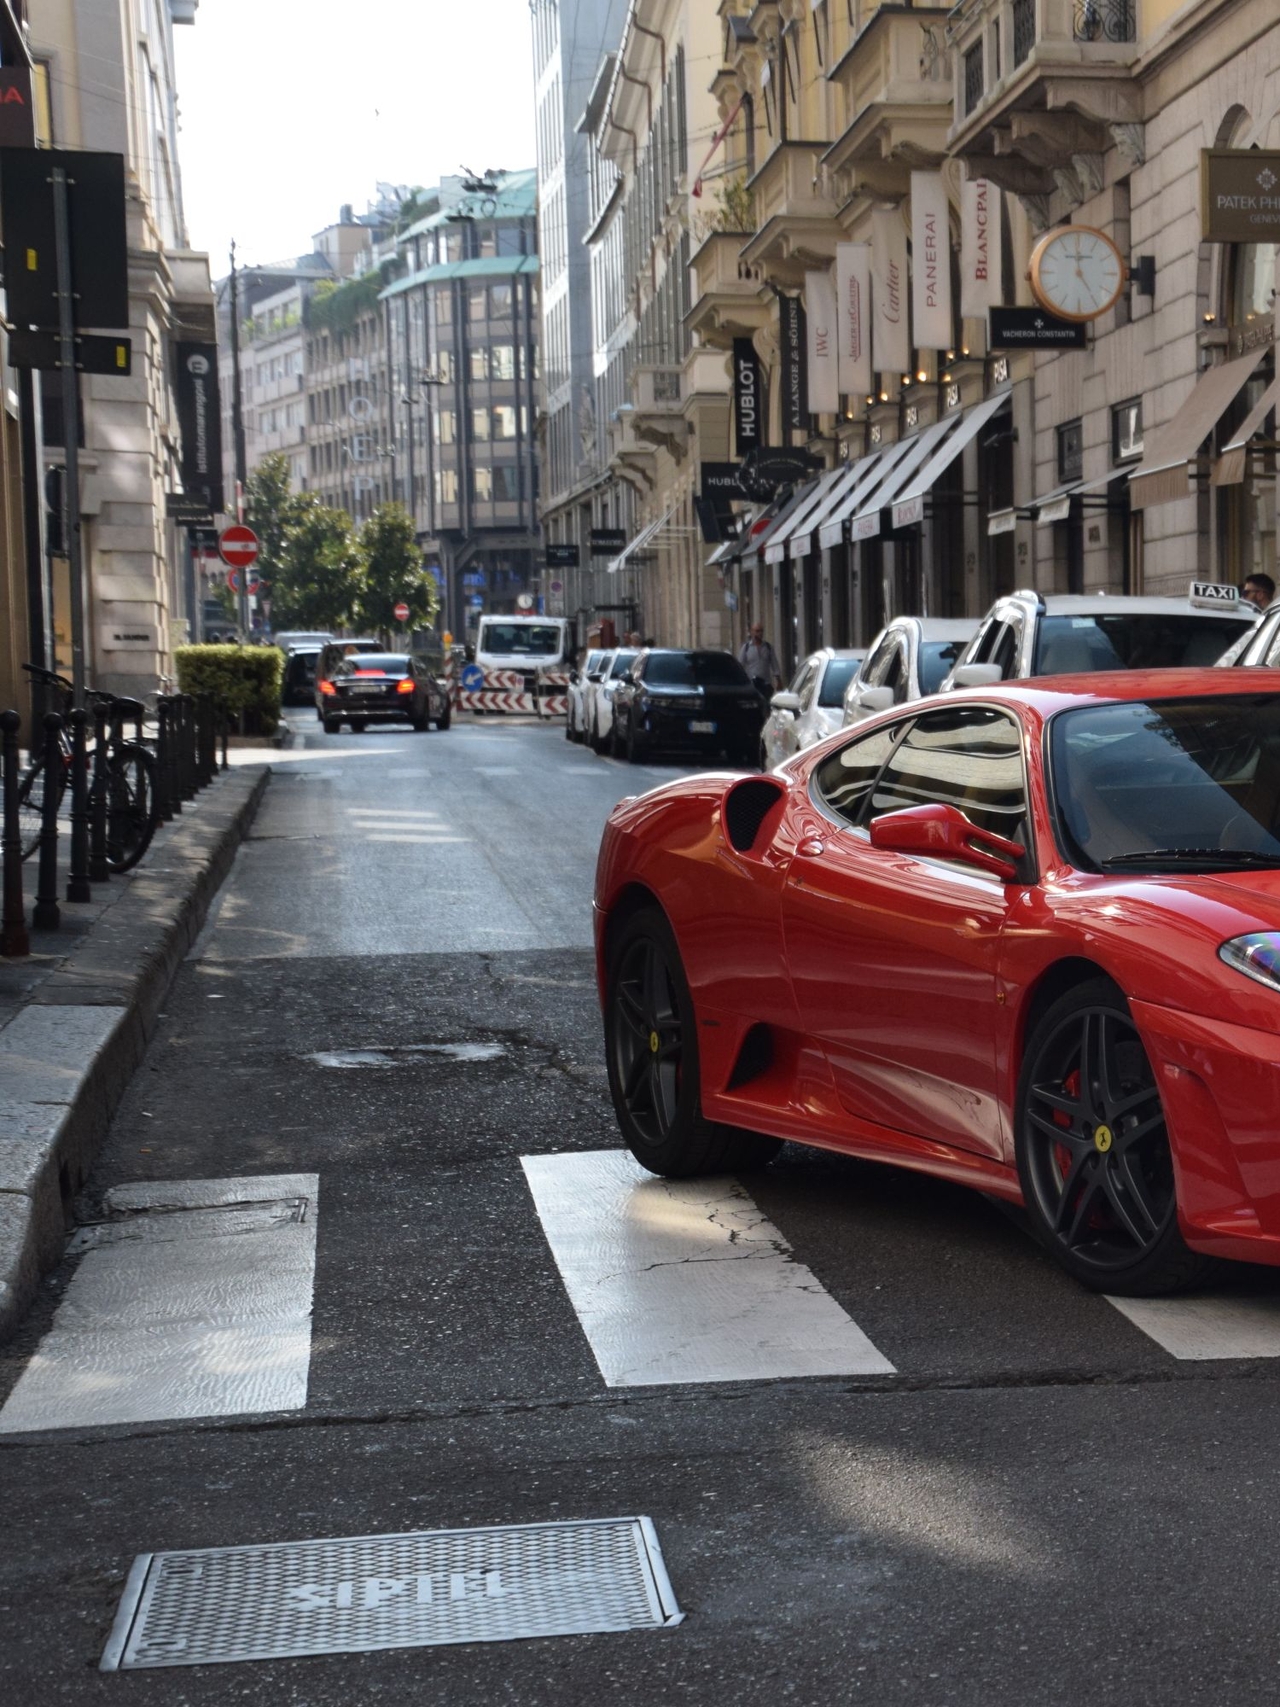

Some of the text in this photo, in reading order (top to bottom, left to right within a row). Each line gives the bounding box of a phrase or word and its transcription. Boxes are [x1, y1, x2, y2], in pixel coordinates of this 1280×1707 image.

[1217, 195, 1257, 209] PATEK
[975, 182, 988, 282] BLANCPAI
[925, 212, 938, 308] PANERAI
[882, 260, 899, 324] Cartier
[816, 327, 829, 358] IWC
[1002, 329, 1076, 338] VACHERON CONSTANTIN
[994, 358, 1008, 384] PISA
[740, 360, 756, 437] HUBLOT
[350, 357, 374, 525] HOEP
[708, 477, 738, 486] HUBL
[1195, 584, 1233, 599] TAXI
